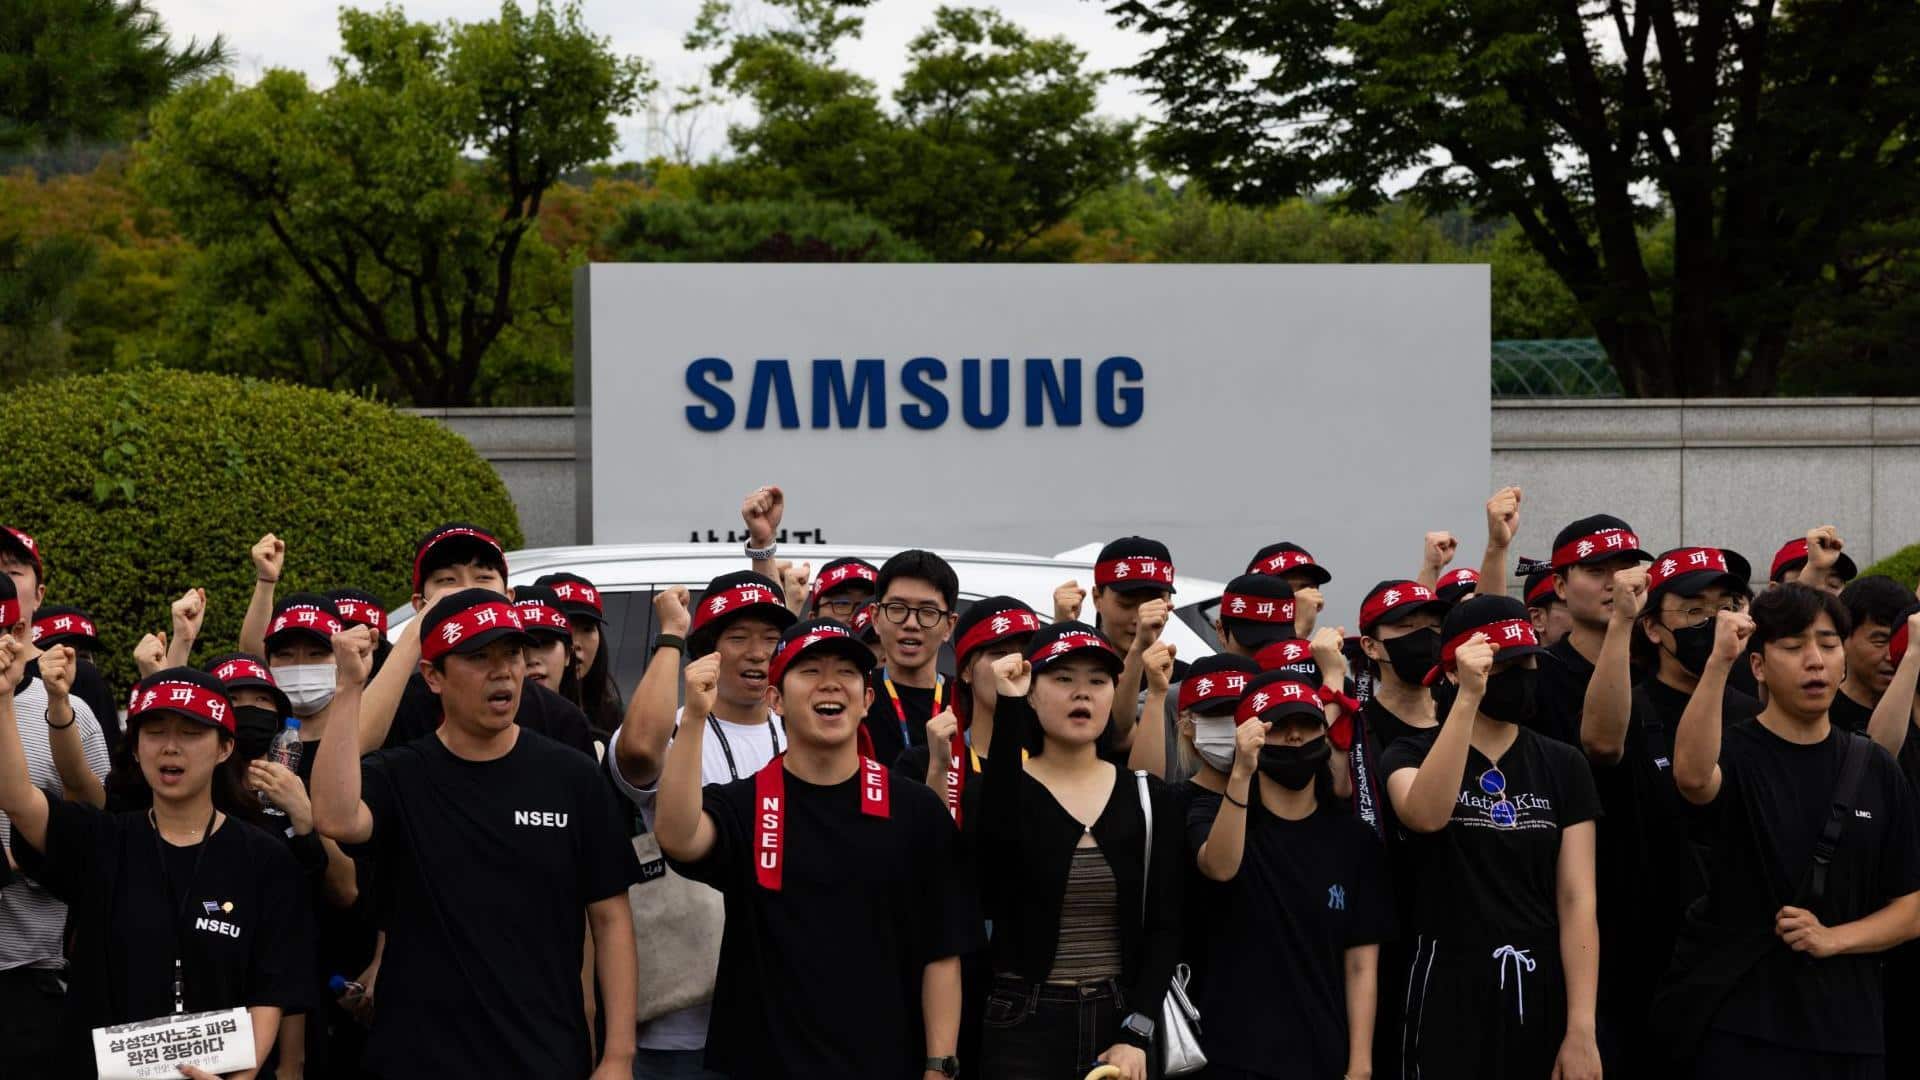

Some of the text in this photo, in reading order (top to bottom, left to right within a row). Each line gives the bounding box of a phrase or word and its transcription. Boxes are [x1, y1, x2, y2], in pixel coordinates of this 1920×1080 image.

[685, 356, 1145, 432] SAMSUNG
[1114, 562, 1173, 582] 총파업
[554, 584, 594, 603] 파업
[1384, 587, 1431, 606] 총파
[337, 604, 380, 626] 파업
[1230, 597, 1294, 619] 총파업
[442, 608, 523, 644] 총파업
[991, 607, 1040, 634] 총파
[217, 663, 267, 680] 파업
[1196, 675, 1247, 697] 총파
[140, 688, 226, 722] 총파업
[1512, 793, 1552, 810] Kim
[514, 811, 569, 828] NSEU
[761, 797, 780, 869] NSEU
[1327, 884, 1345, 910] NY
[196, 917, 241, 938] NSEU
[109, 1018, 238, 1053] 삼성전자노조 파업
[127, 1049, 160, 1067] 완전
[162, 1036, 225, 1062] 정당하다
